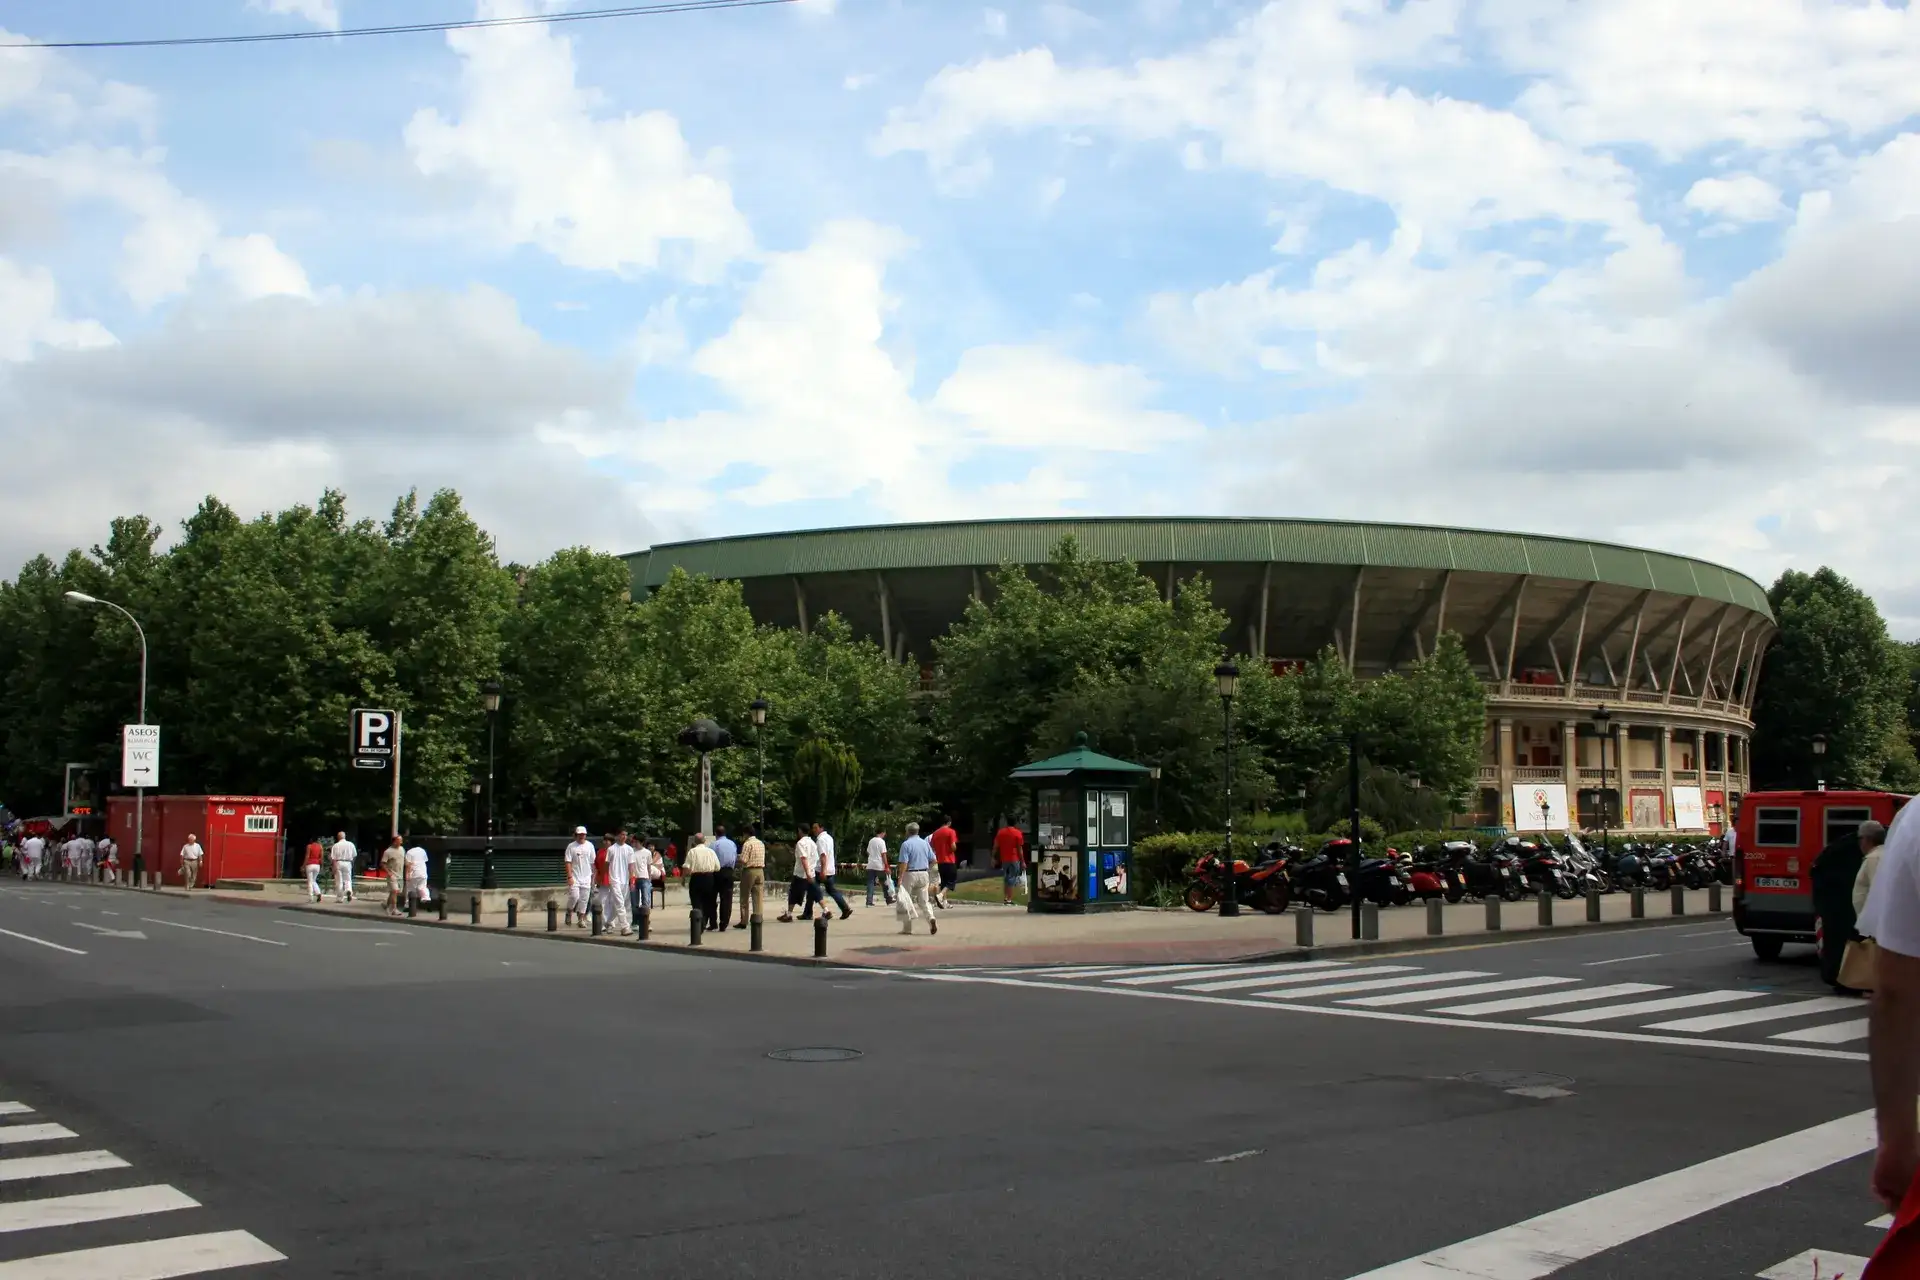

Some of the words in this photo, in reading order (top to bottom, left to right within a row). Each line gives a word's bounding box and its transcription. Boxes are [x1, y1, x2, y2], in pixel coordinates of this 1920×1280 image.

[128, 728, 158, 736] ASEOS
[361, 712, 389, 746] P
[132, 751, 152, 760] WC
[251, 804, 273, 814] WC
[1529, 812, 1556, 821] Navara
